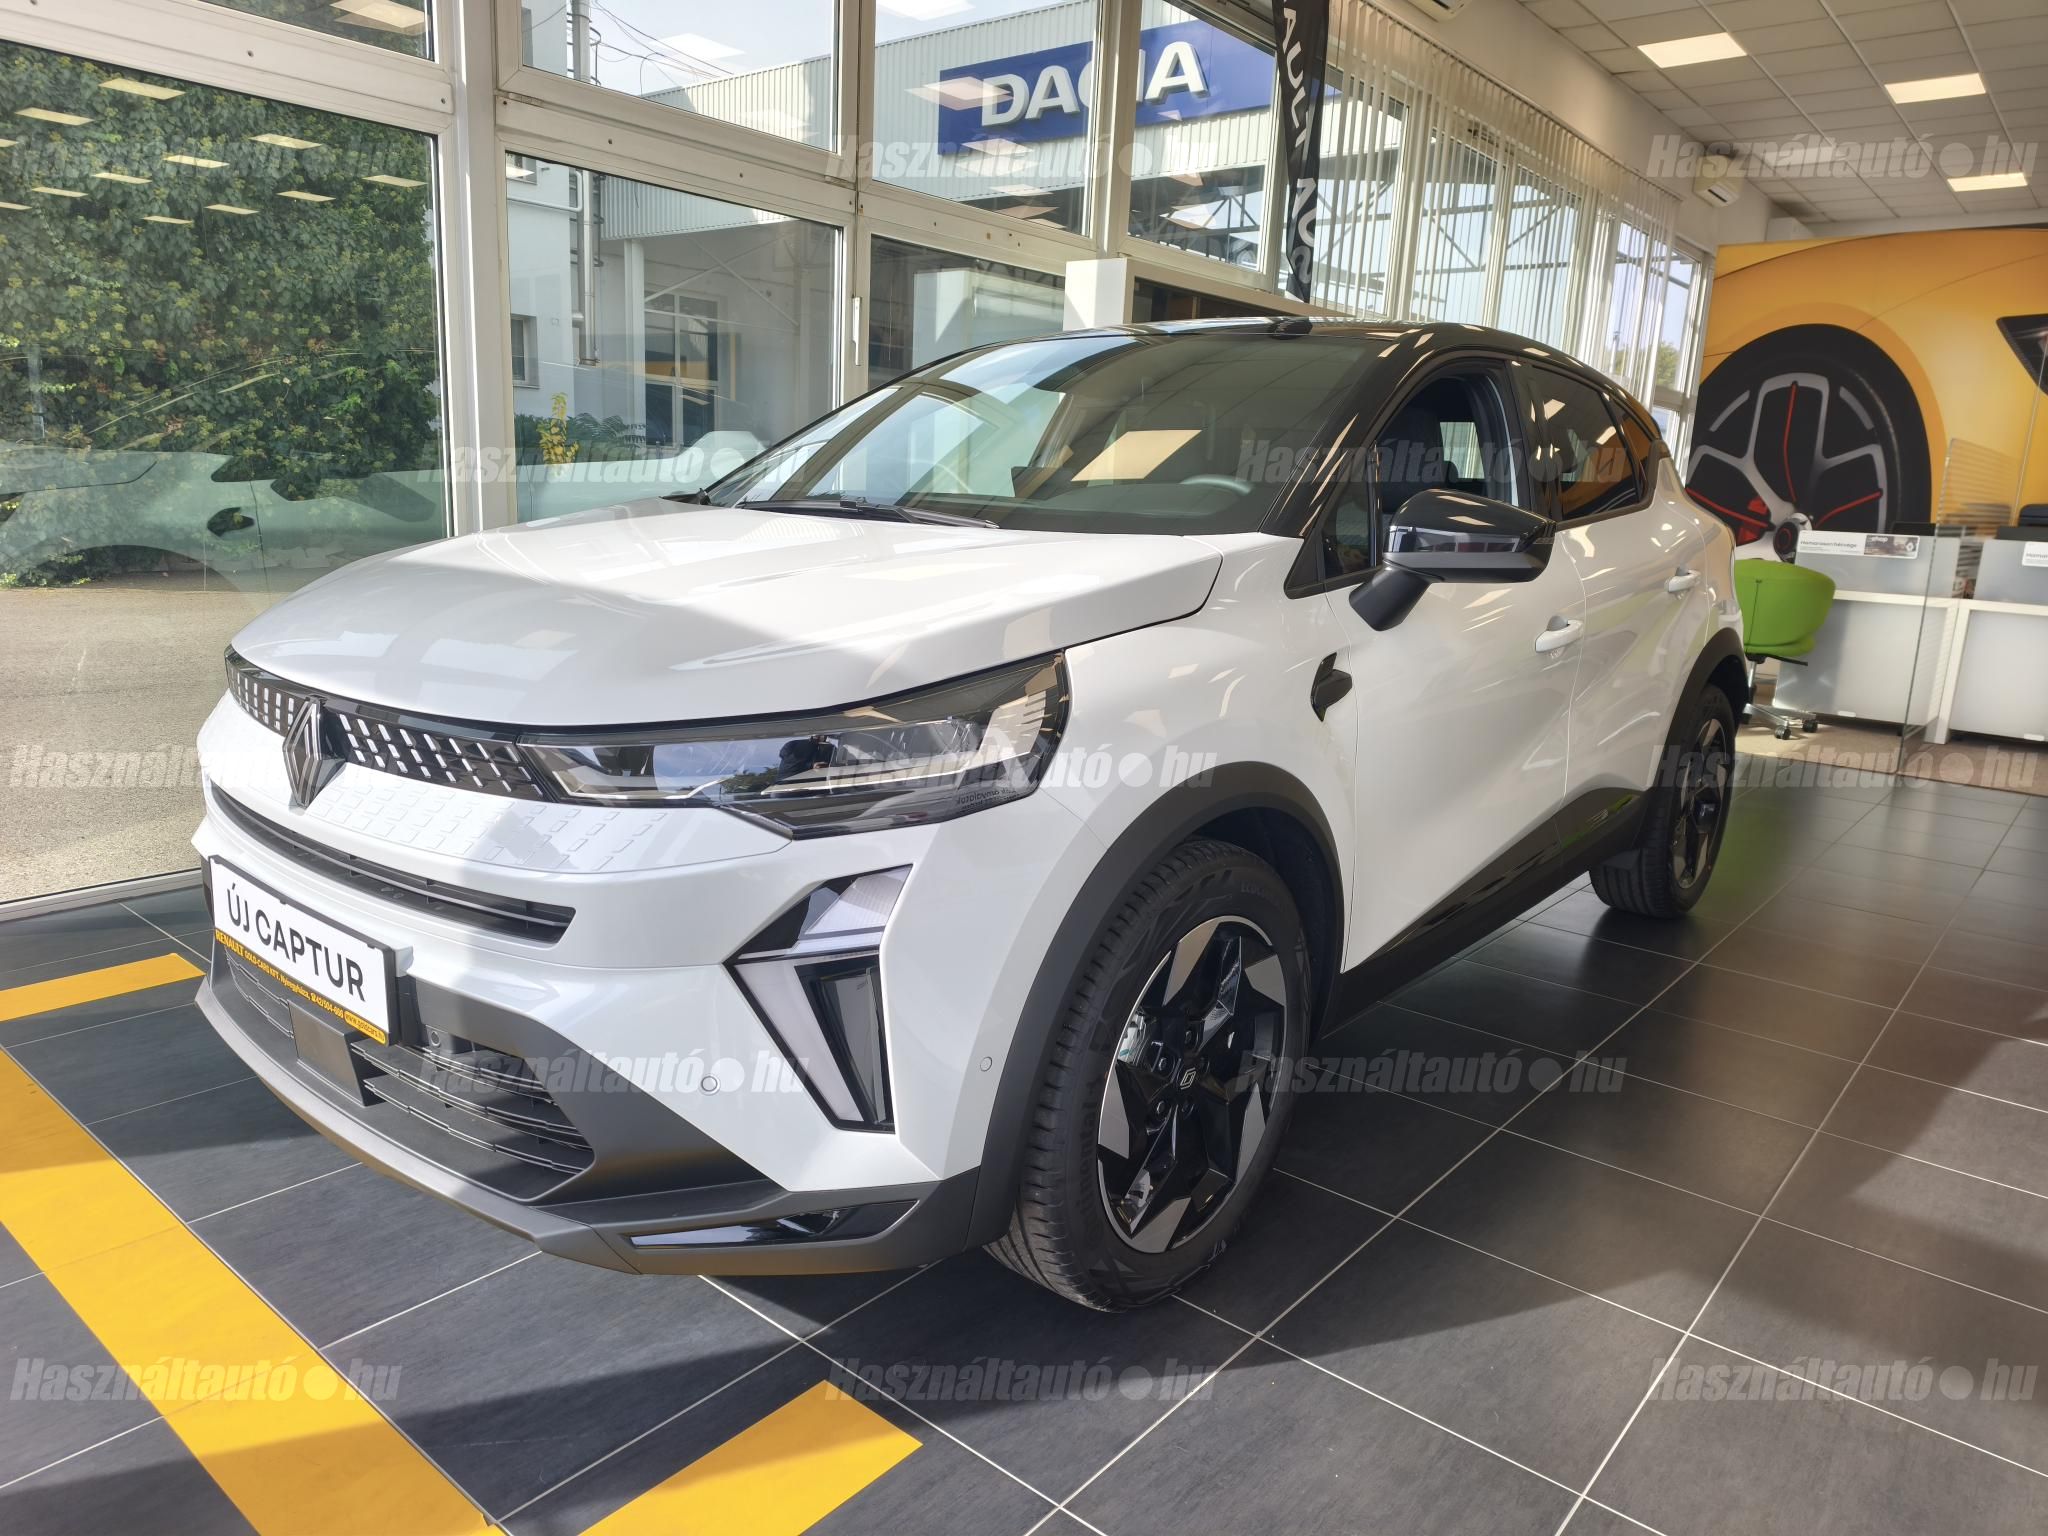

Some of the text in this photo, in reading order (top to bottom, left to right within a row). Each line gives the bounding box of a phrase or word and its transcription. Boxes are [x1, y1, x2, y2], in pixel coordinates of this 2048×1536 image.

[1283, 0, 1307, 148] AULT
[215, 929, 244, 957] RENAULT
[227, 883, 366, 1002] ÚJ CAPTUR
